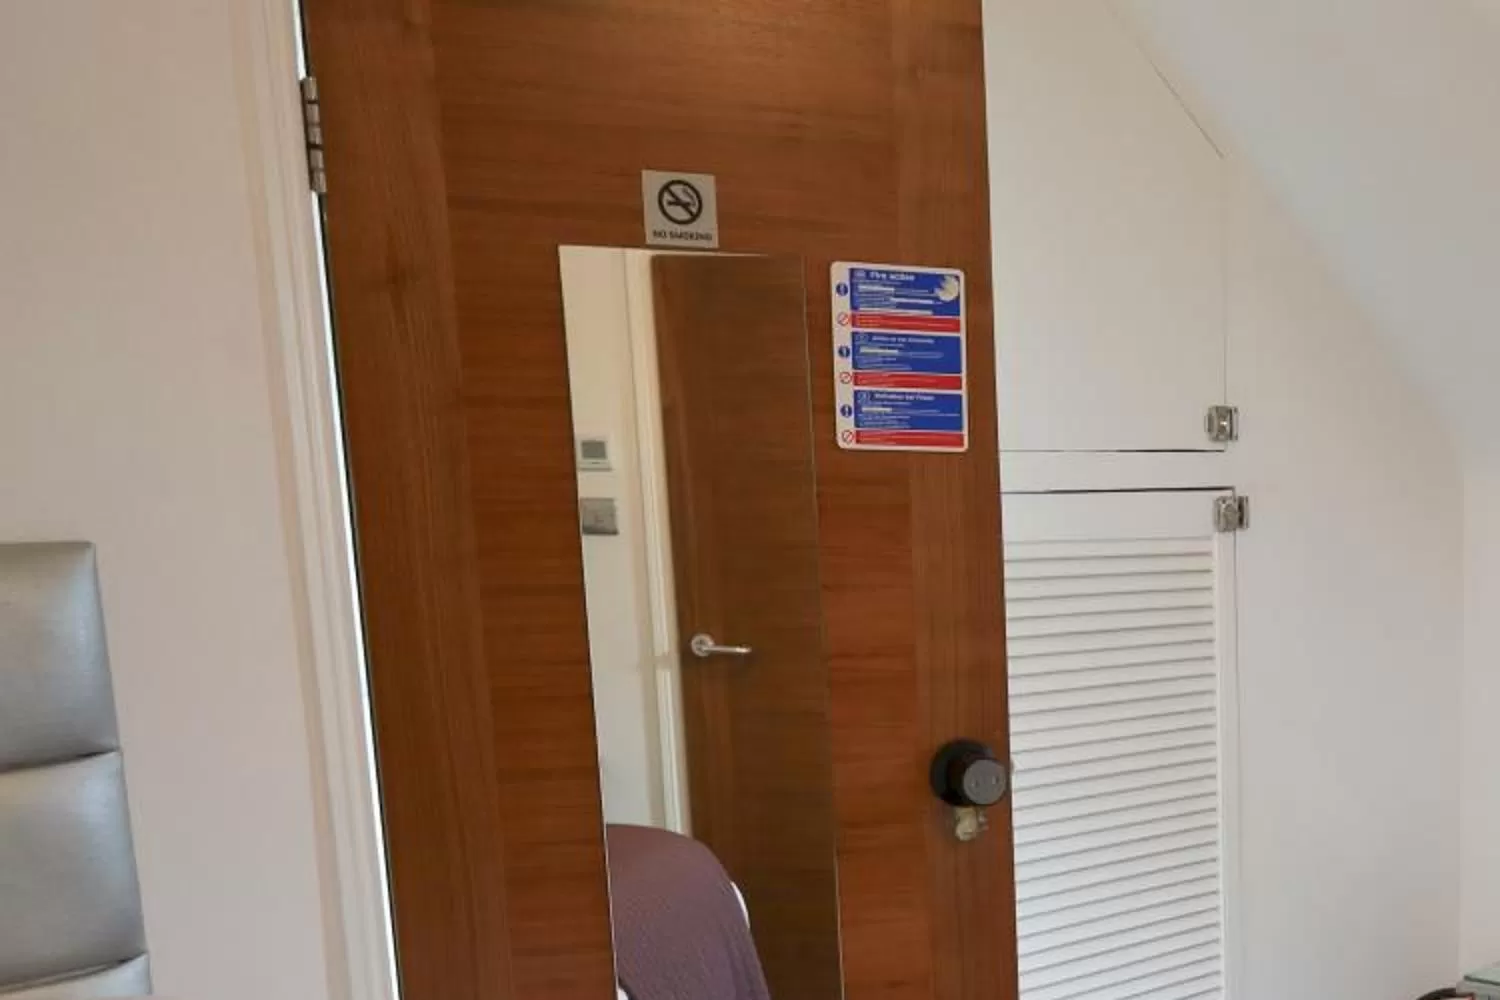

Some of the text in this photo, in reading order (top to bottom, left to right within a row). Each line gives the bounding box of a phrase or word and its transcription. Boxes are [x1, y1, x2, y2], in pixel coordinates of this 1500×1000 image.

[653, 230, 713, 241] NO SMOKING
[870, 271, 887, 281] Fire
